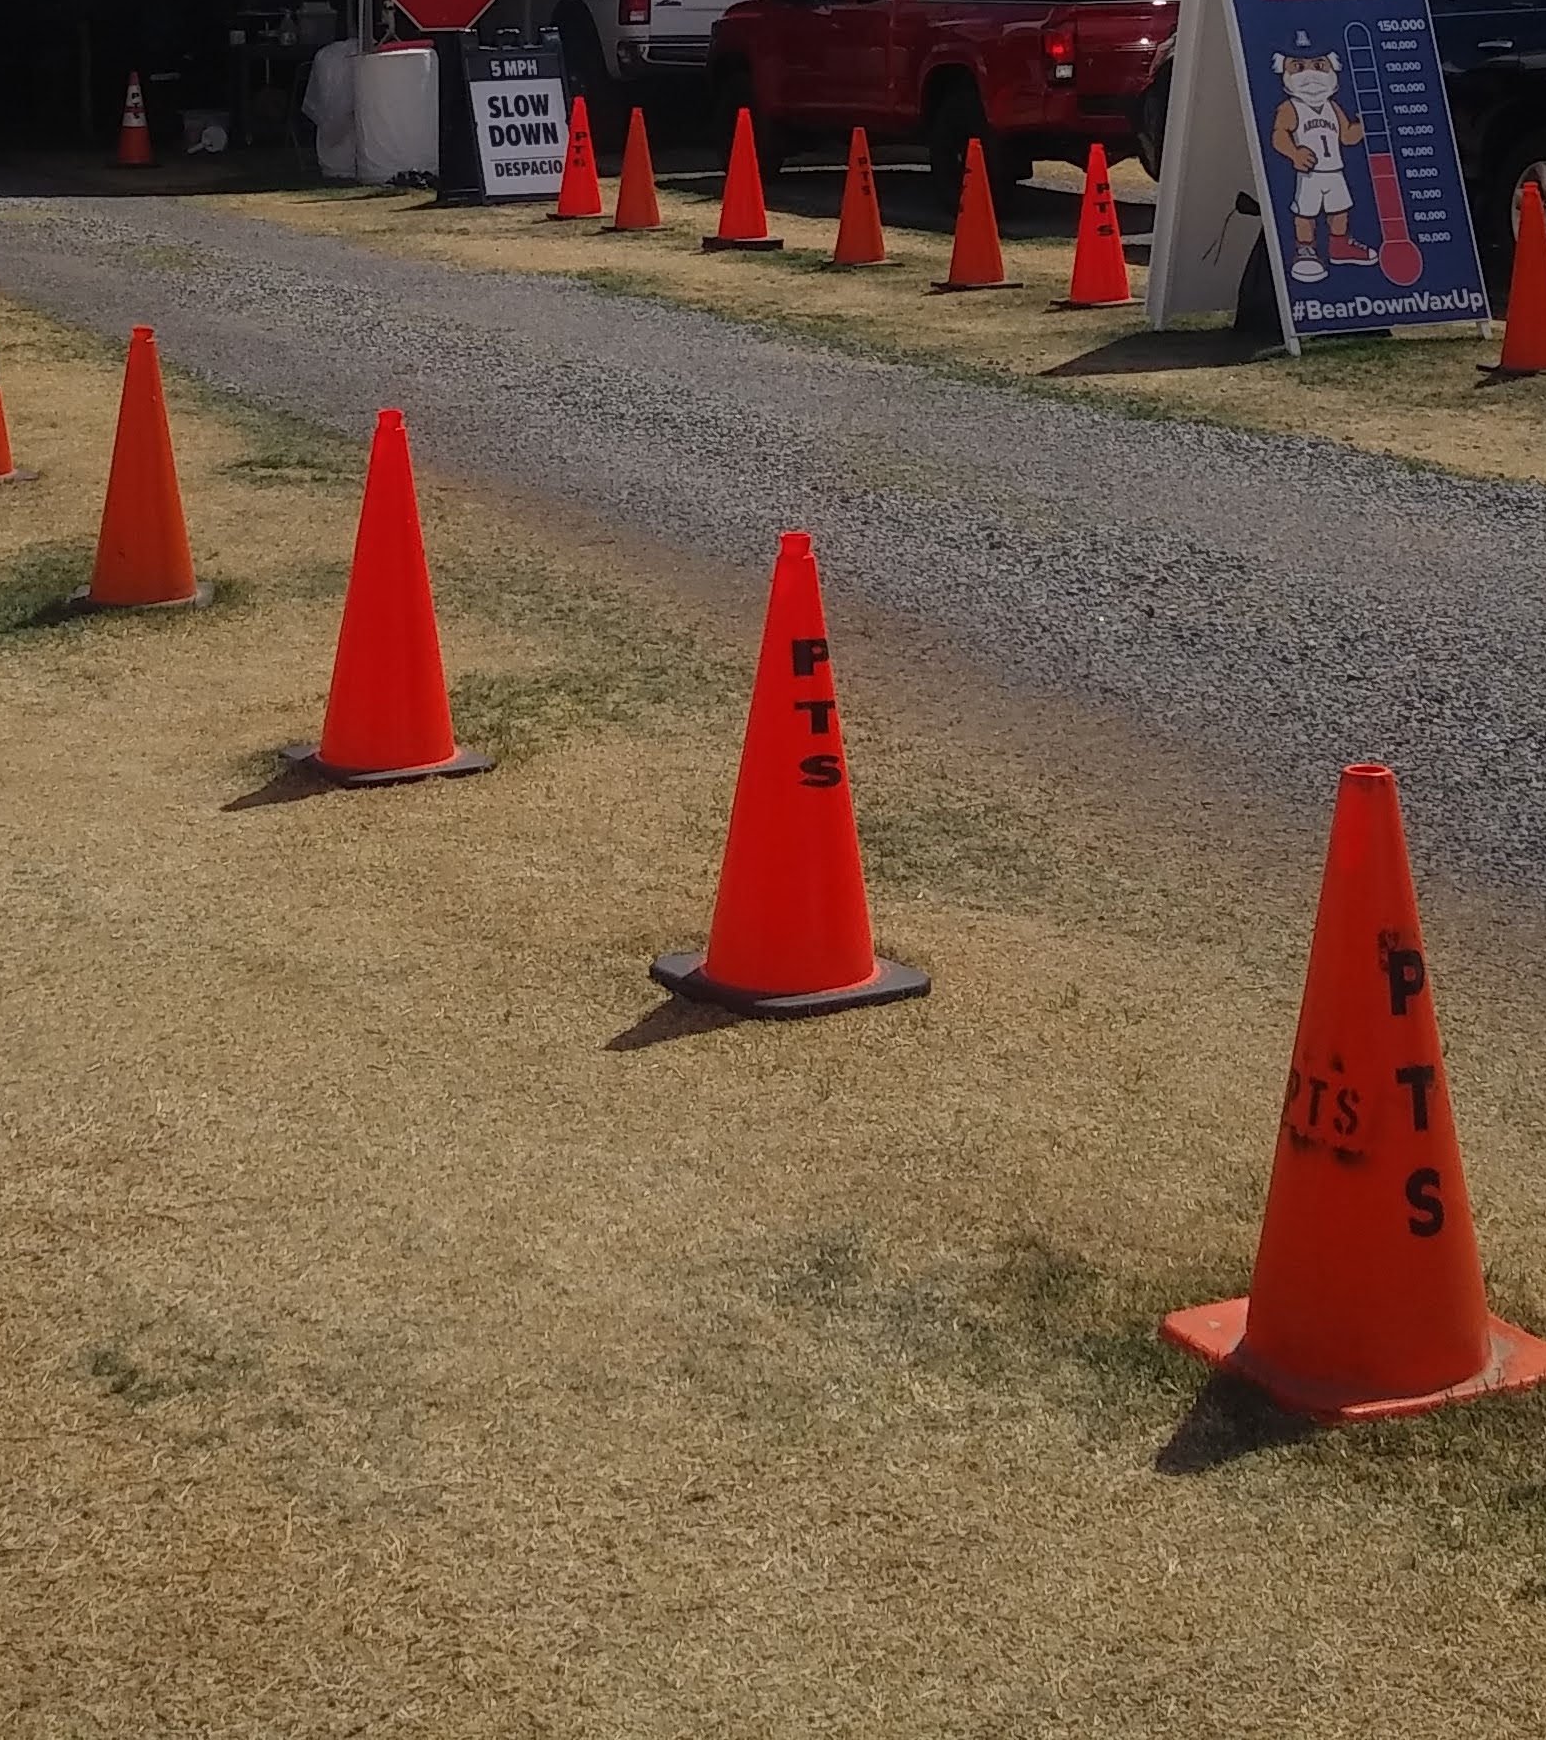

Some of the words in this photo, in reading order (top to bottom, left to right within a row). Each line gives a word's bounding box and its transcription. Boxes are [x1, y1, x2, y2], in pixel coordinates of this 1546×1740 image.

[1377, 19, 1425, 32] 150,000
[1381, 40, 1417, 51] 140,000
[491, 61, 502, 77] 5
[504, 59, 538, 76] MPH
[1385, 62, 1421, 72] 130,000
[1389, 83, 1425, 93] 120,000
[488, 94, 549, 119] SLOW
[1393, 104, 1428, 114] 110,000
[1303, 119, 1337, 133] ARIZONA
[1397, 125, 1434, 136] 100,000
[488, 122, 559, 147] DOWN
[1320, 135, 1331, 158] 1
[1401, 146, 1433, 157] 90,000
[495, 160, 563, 178] DESPACIO
[1406, 168, 1438, 179] 80,000
[1410, 189, 1442, 200] 70,000
[1414, 211, 1446, 222] 60,000
[1418, 232, 1451, 243] 50,000
[1291, 288, 1483, 323] #BearDownVaxUp
[791, 638, 842, 788] PTS
[1388, 949, 1445, 1238] PTS
